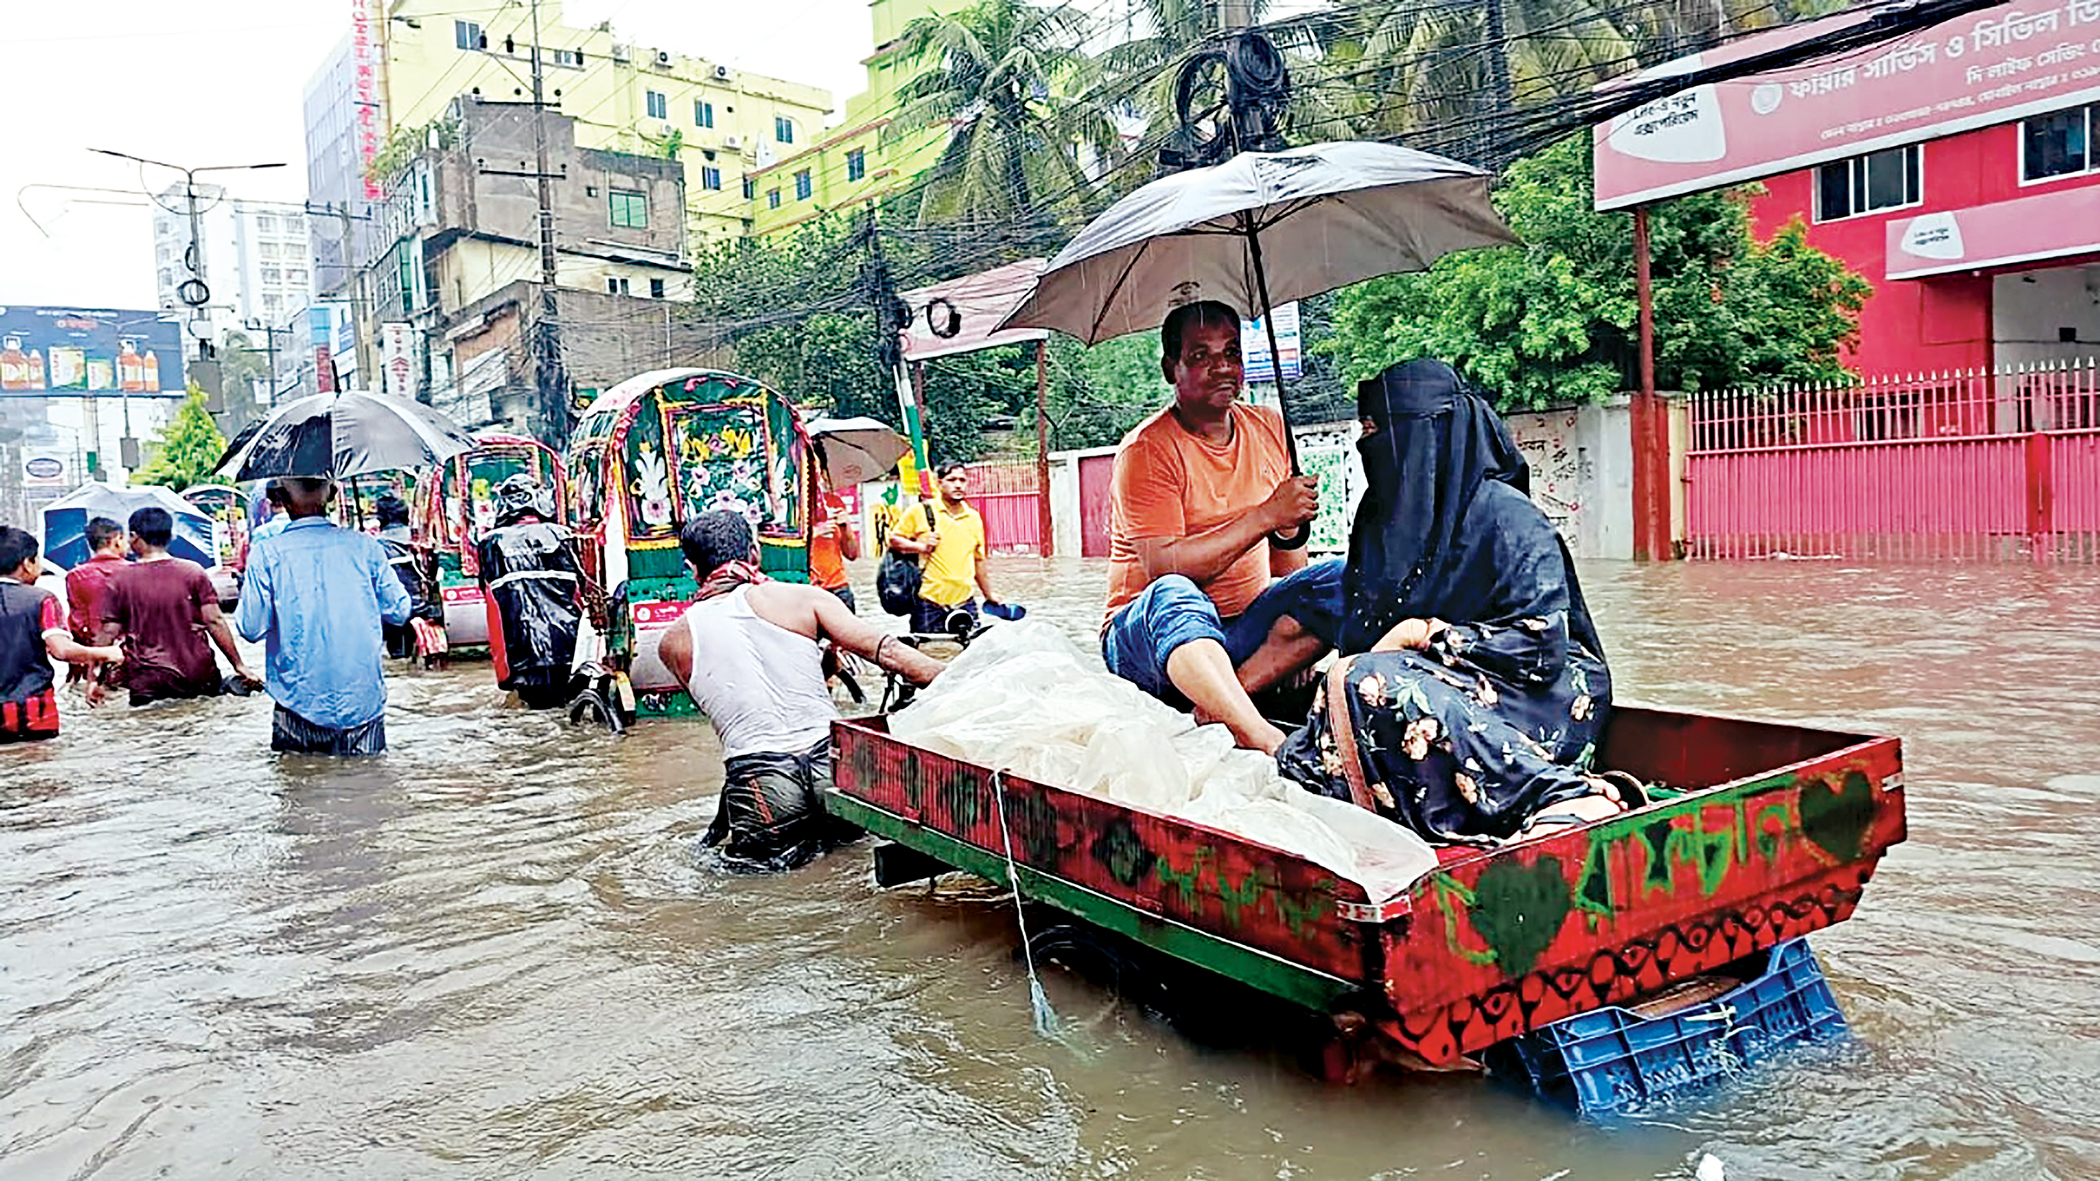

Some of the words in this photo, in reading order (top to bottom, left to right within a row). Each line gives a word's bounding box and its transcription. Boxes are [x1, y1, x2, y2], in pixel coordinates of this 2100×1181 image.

[1863, 41, 1937, 79] সার্ভিস
[1945, 36, 1964, 58] ও
[1970, 10, 2061, 51] সিভিল
